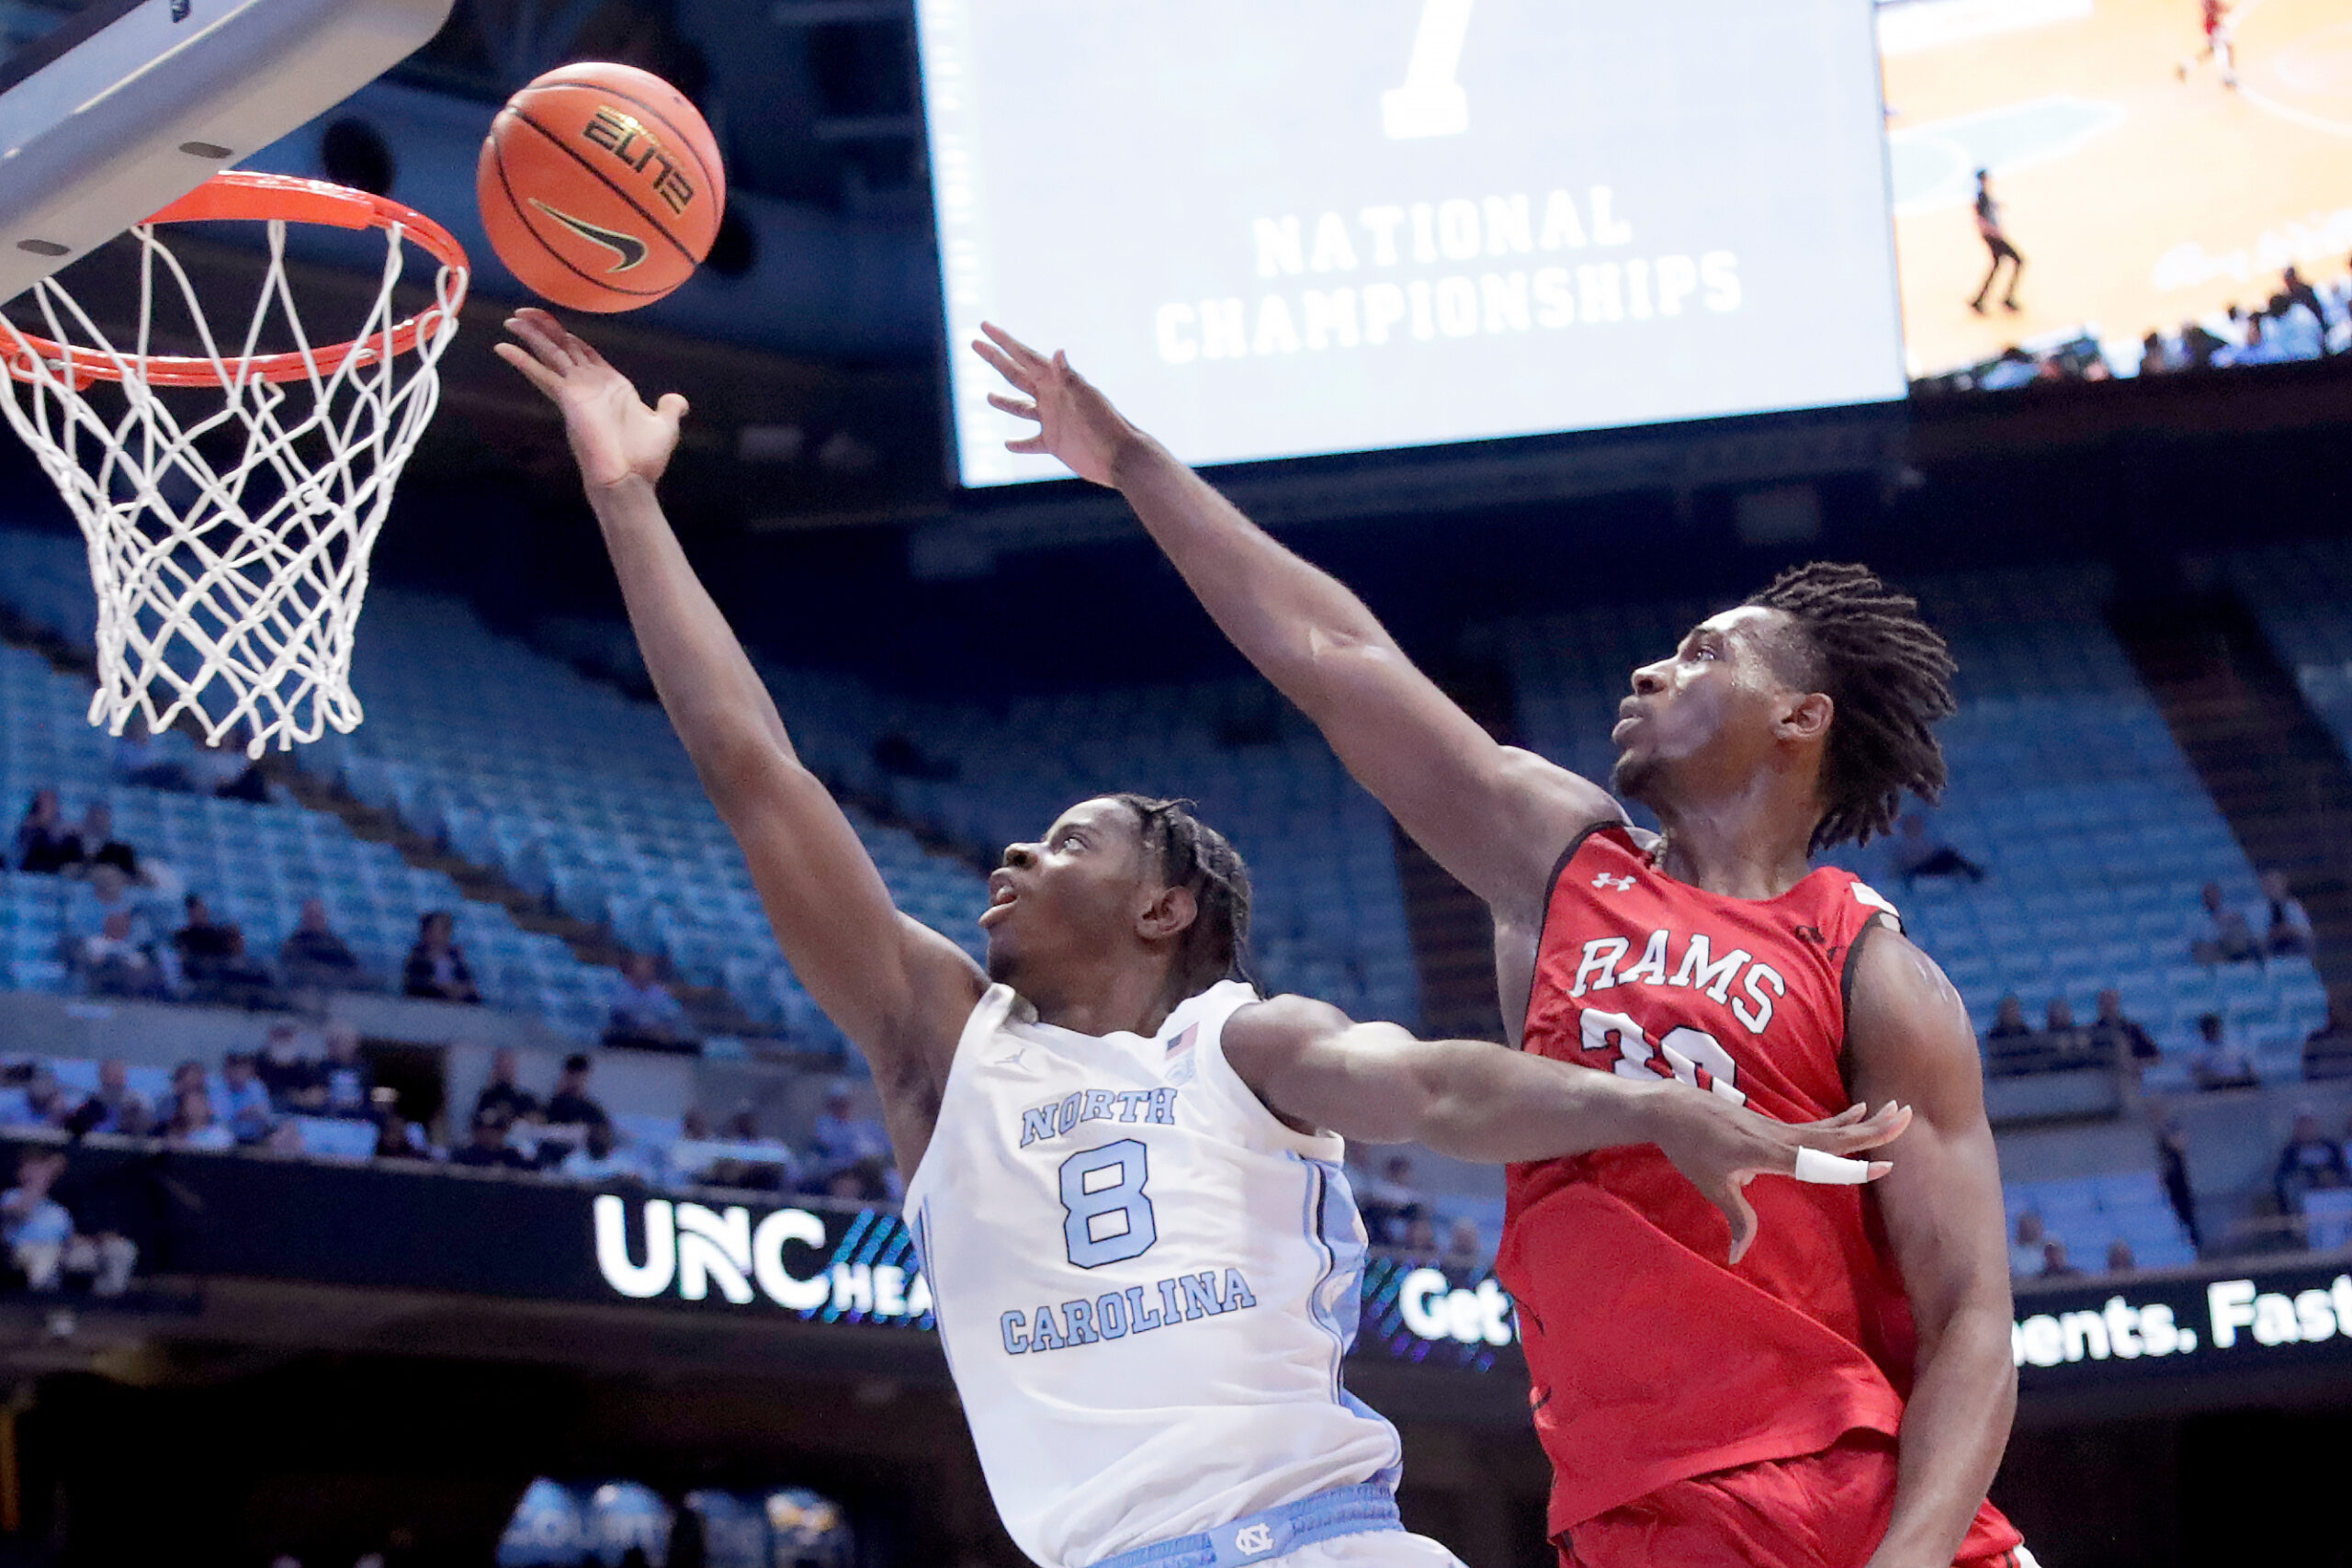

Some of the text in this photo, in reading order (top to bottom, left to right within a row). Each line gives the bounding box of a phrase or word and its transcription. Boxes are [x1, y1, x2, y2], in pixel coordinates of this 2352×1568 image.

[582, 111, 695, 215] ELITE
[1252, 186, 1631, 277] NATIONAL
[1155, 251, 1742, 364] CHAMPIONSHIPS
[1567, 929, 1786, 1035] RAMS
[1020, 1088, 1178, 1148] NORTH
[594, 1194, 827, 1310] UNC
[1058, 1138, 1158, 1269] 8
[1001, 1268, 1257, 1355] CAROLINA
[1398, 1268, 1512, 1347] Get
[2011, 1294, 2198, 1367] ents.
